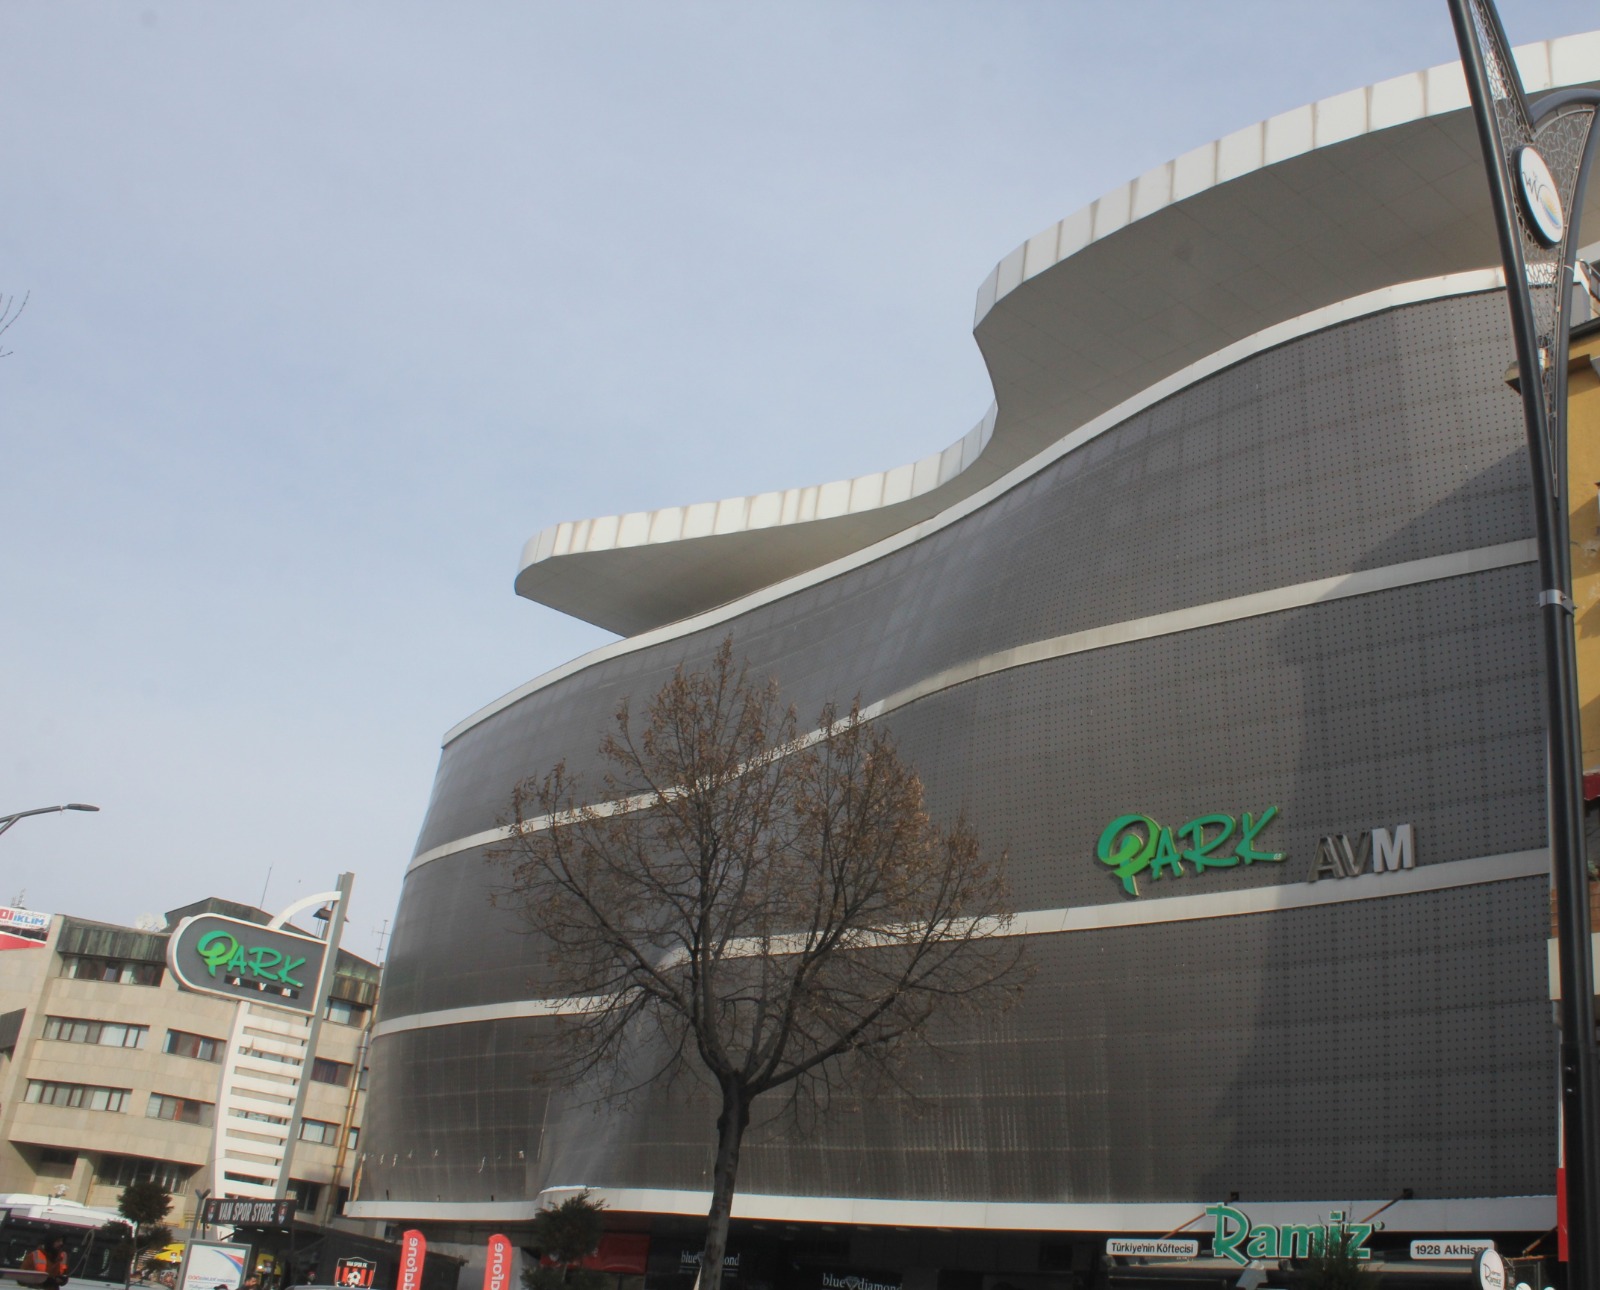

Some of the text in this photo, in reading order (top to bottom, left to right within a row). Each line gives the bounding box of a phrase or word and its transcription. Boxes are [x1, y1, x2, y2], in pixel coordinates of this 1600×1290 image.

[1096, 806, 1415, 896] PARK AVM
[197, 930, 306, 988] PARK
[218, 1202, 276, 1223] VAN SPOR STORE
[1111, 1242, 1194, 1254] Türkiye'nin Köftecisi
[1415, 1245, 1441, 1255] 1928
[681, 1250, 697, 1264] blue
[822, 1272, 846, 1289] blue
